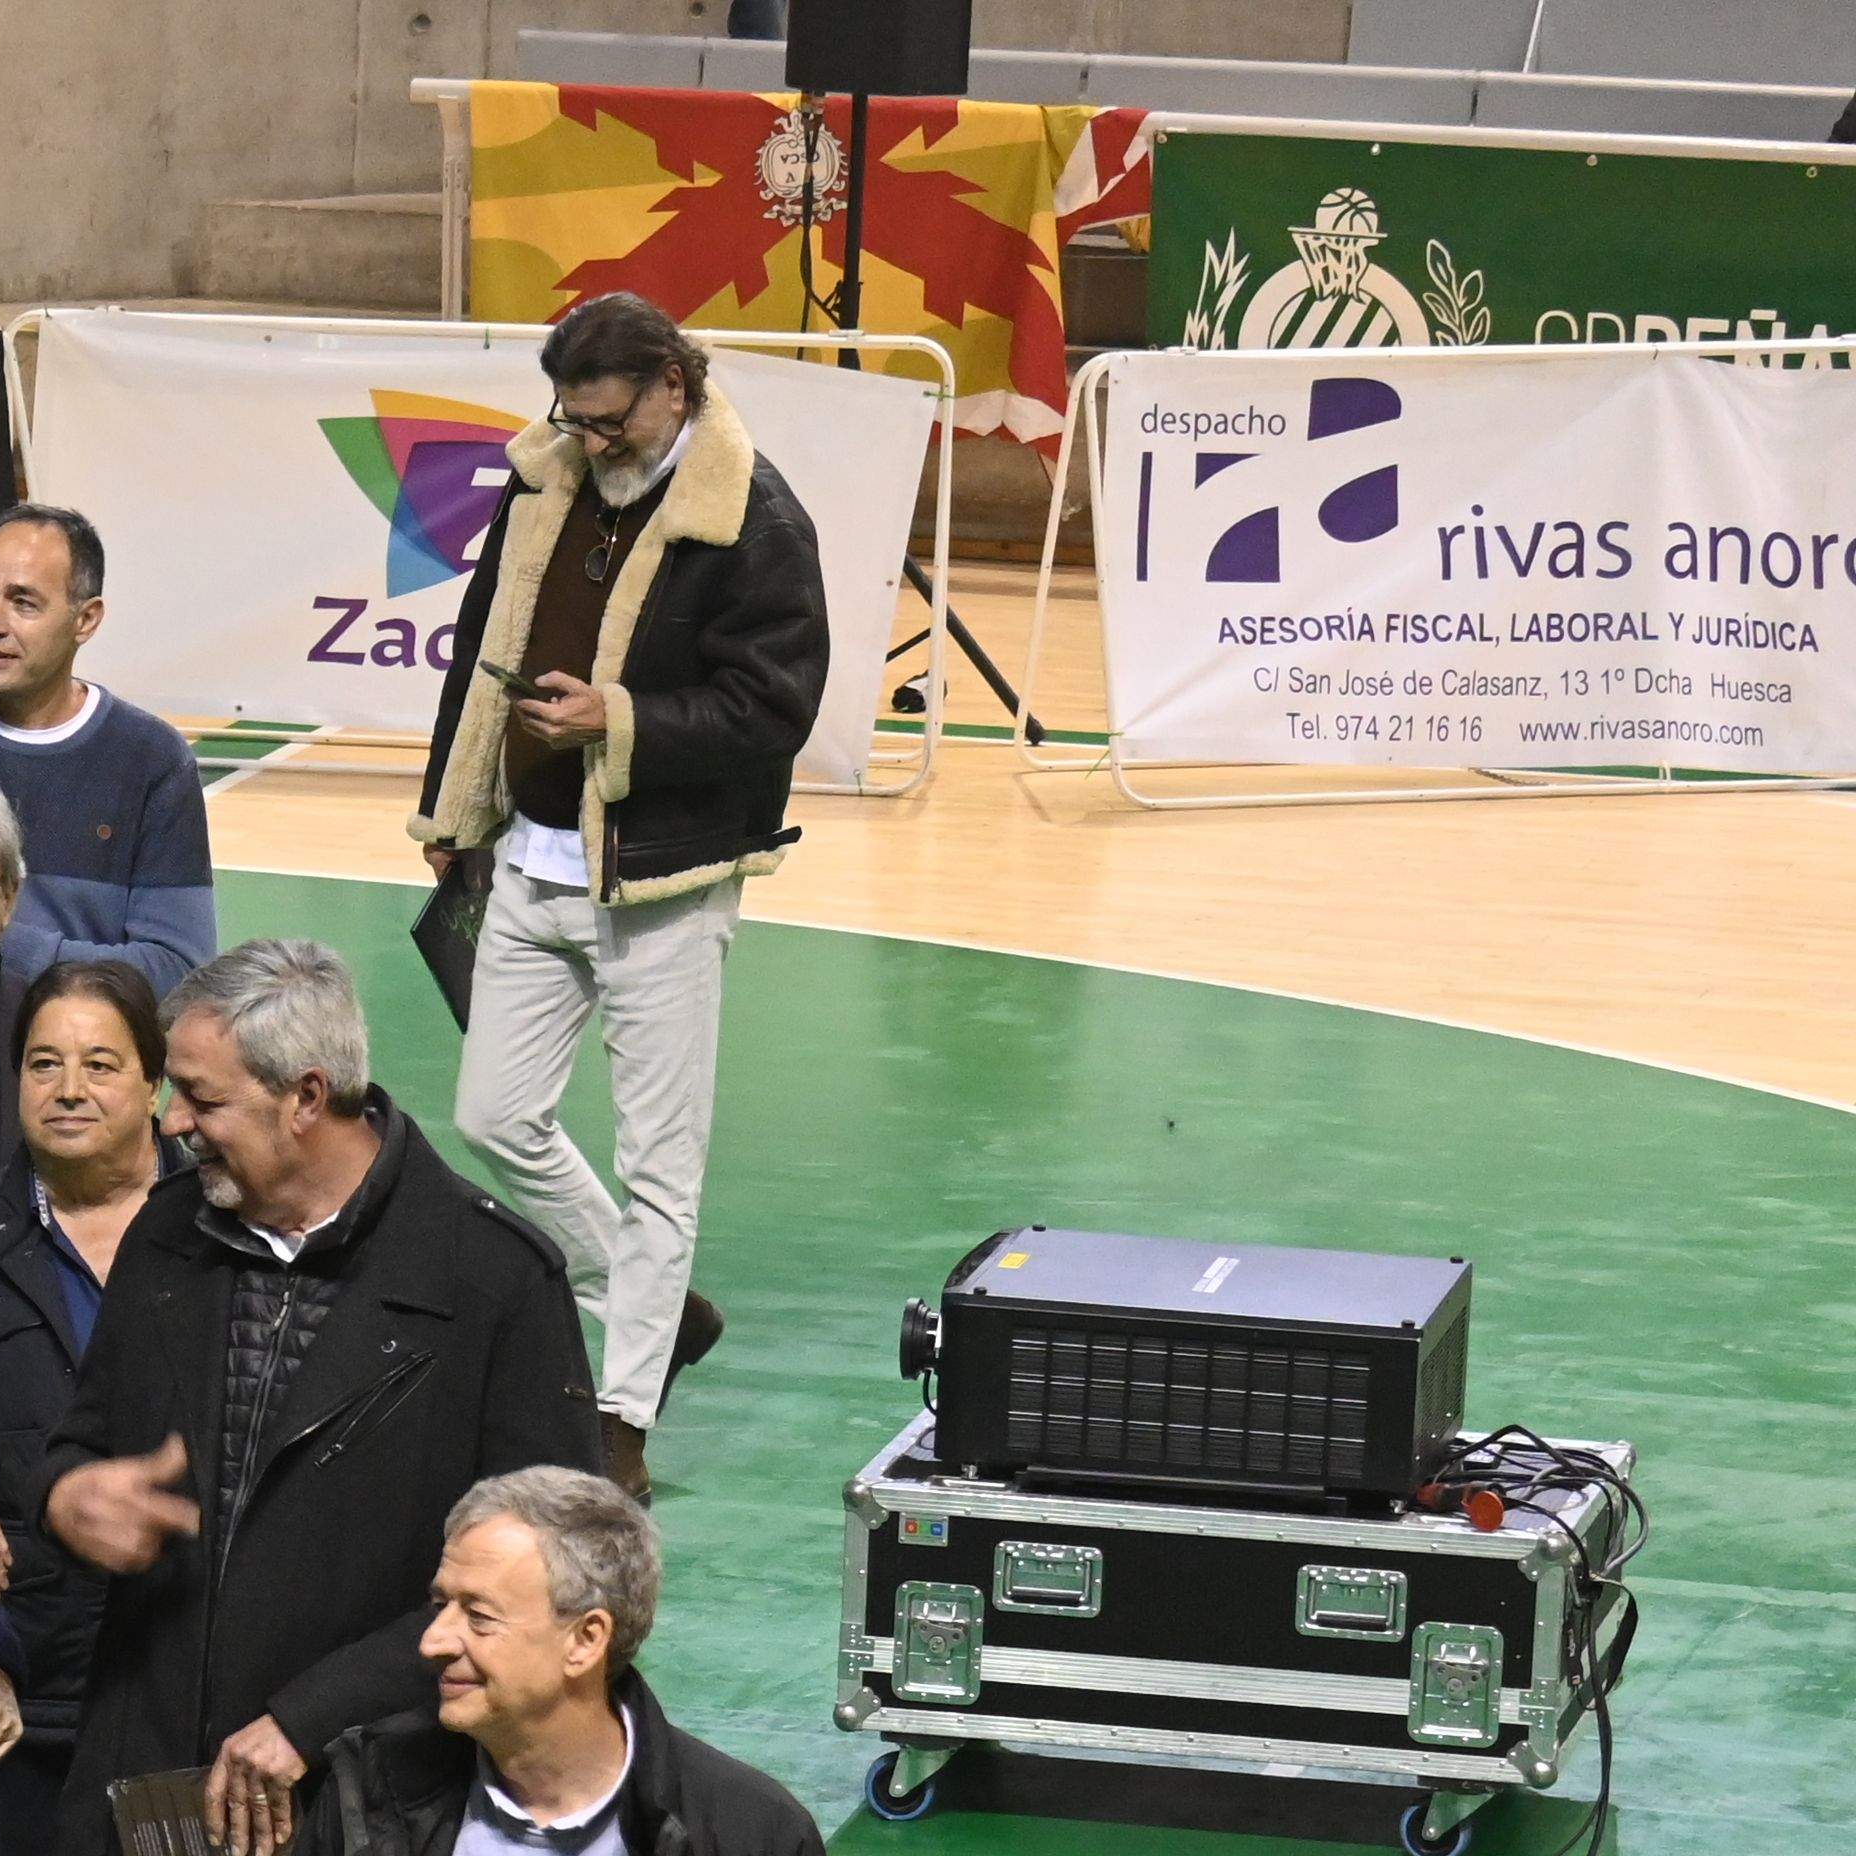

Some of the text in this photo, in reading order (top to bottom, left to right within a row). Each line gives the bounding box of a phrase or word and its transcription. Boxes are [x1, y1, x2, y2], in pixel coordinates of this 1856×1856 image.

[1140, 403, 1286, 442] despacho
[1438, 504, 1632, 580] rivas
[307, 596, 455, 672] Zac
[1219, 606, 1820, 652] ASESORÍA FISCAL, LABORAL Y JURÍDICA
[1253, 666, 1279, 693] C/
[1289, 667, 1330, 695] San
[1339, 669, 1393, 696] José
[1403, 669, 1432, 695] de
[1442, 669, 1548, 700] Calasanz,
[1561, 669, 1589, 695] 13
[1635, 667, 1692, 695] Dcha
[1711, 673, 1792, 704] Huesca
[1286, 713, 1482, 742] Tel. 974 21 16 16
[1519, 719, 1763, 747] www.rivasanoro.com
